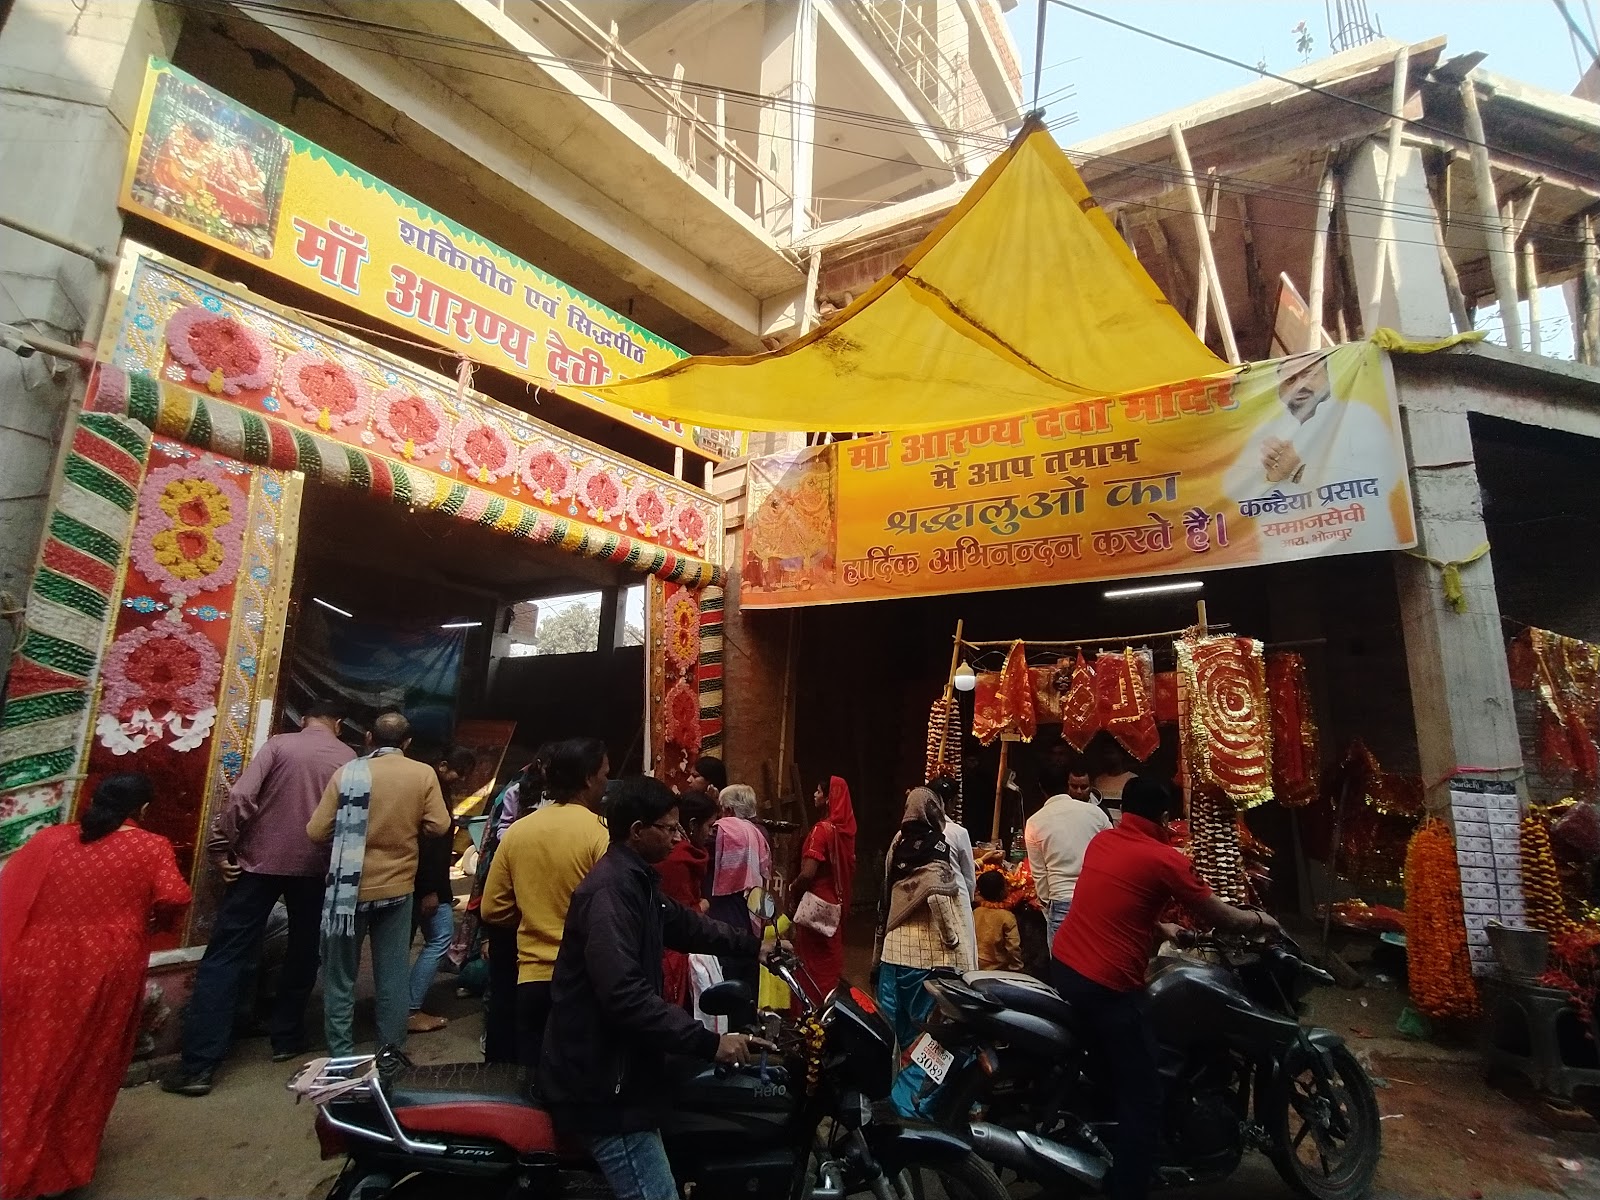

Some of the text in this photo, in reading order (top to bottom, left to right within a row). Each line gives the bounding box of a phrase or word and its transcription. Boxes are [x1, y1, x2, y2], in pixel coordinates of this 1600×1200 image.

[398, 218, 647, 364] शक्तिपीठ एवं सिद्धपीठ
[386, 264, 536, 369] आरण्य
[546, 328, 612, 388] देवी
[900, 414, 1028, 465] आरण्य
[930, 438, 1142, 491] में आप तमाम
[883, 471, 1181, 536] श्रद्धालुओं का
[1238, 477, 1379, 519] कन्हैया प्रसाद
[1262, 503, 1366, 537] समाजसेवी
[842, 544, 920, 586] हार्दिक
[927, 533, 1082, 575] अभिनन्दन
[1091, 512, 1173, 556] करते
[1312, 528, 1353, 543] भोजपुर
[754, 1085, 787, 1097] Hero
[916, 1052, 943, 1081] 3082
